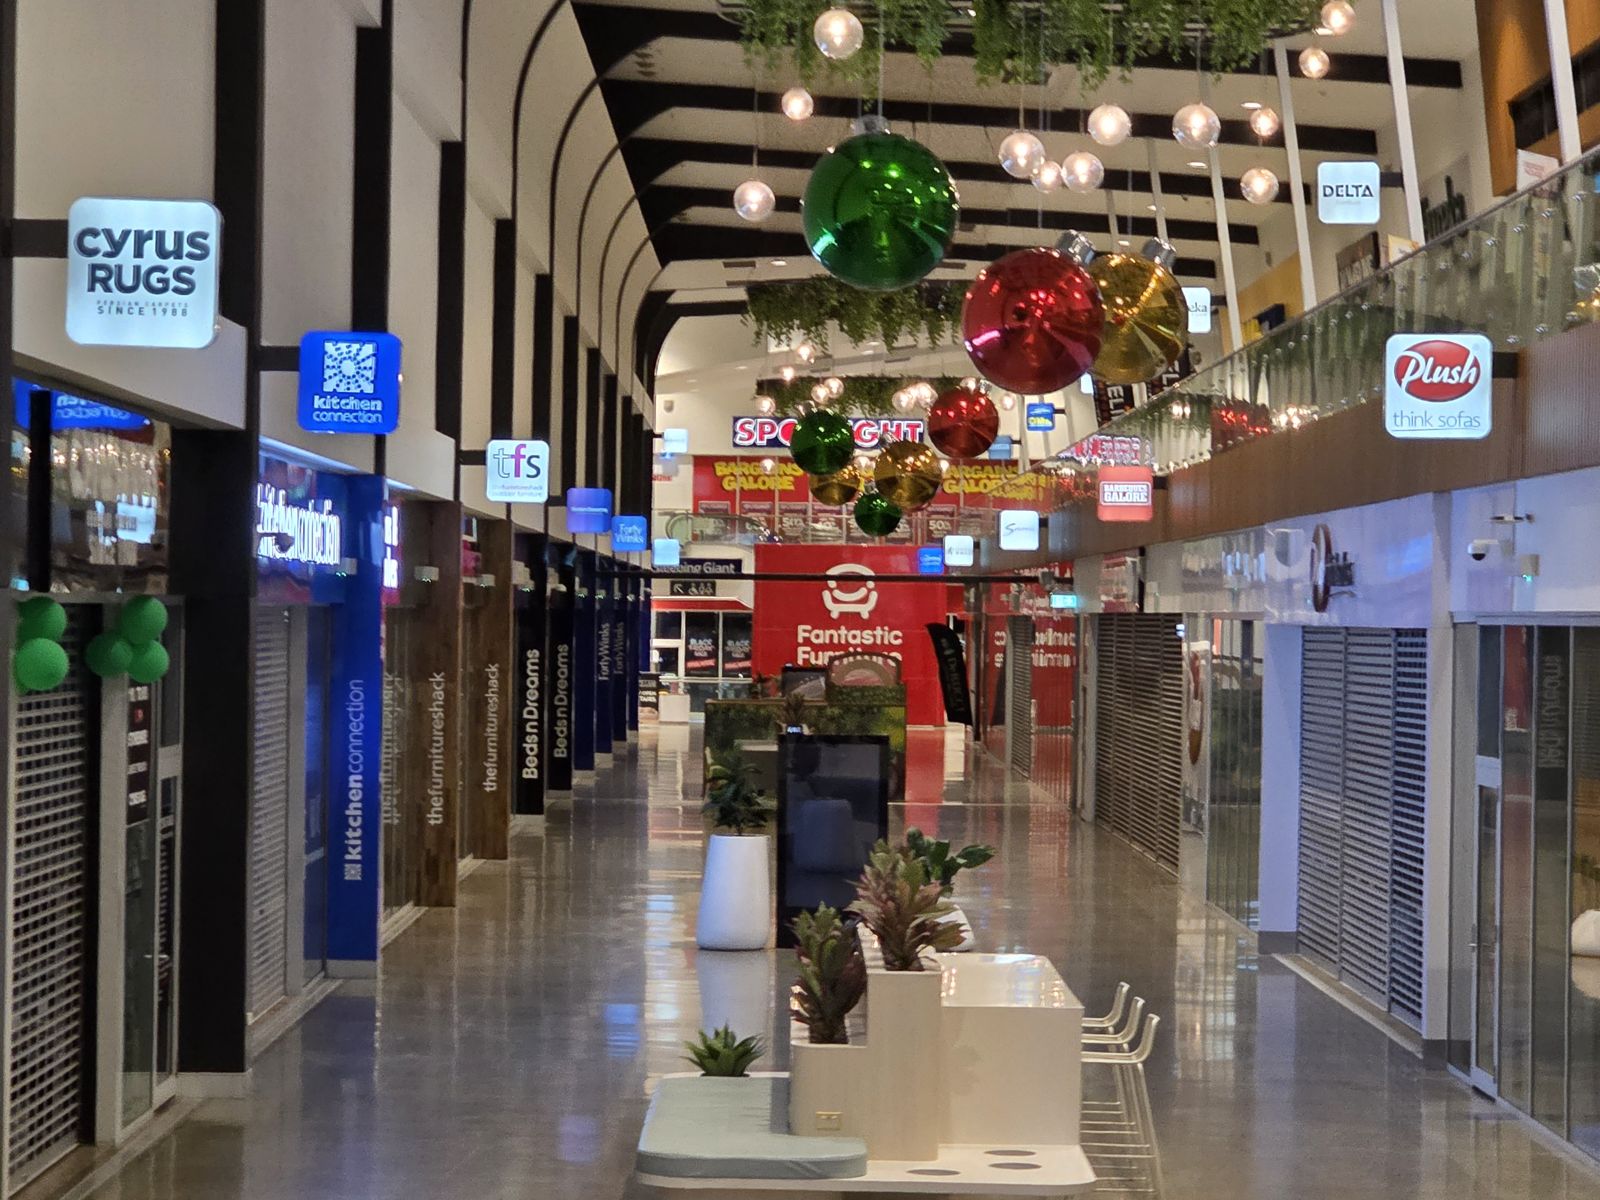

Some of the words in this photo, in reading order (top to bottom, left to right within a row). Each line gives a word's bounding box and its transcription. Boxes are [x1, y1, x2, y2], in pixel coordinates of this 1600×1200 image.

[1322, 184, 1374, 198] DELTA
[74, 227, 210, 261] cyrus
[87, 263, 196, 295] RUGS
[97, 306, 145, 316] SINCE
[152, 308, 188, 317] 1988
[1394, 349, 1478, 392] Plush
[313, 395, 382, 411] kitchen
[312, 411, 384, 423] connection
[1393, 410, 1433, 427] think
[1438, 410, 1481, 427] sofas
[493, 443, 541, 478] tfs
[722, 476, 796, 491] GALORE
[1104, 491, 1148, 503] GALORE
[703, 561, 736, 574] Giant
[797, 625, 903, 645] Fantastic
[483, 663, 500, 793] thefurnitureshack
[427, 672, 445, 827] thefurnitureshack
[344, 679, 364, 861] kitchenconnection
